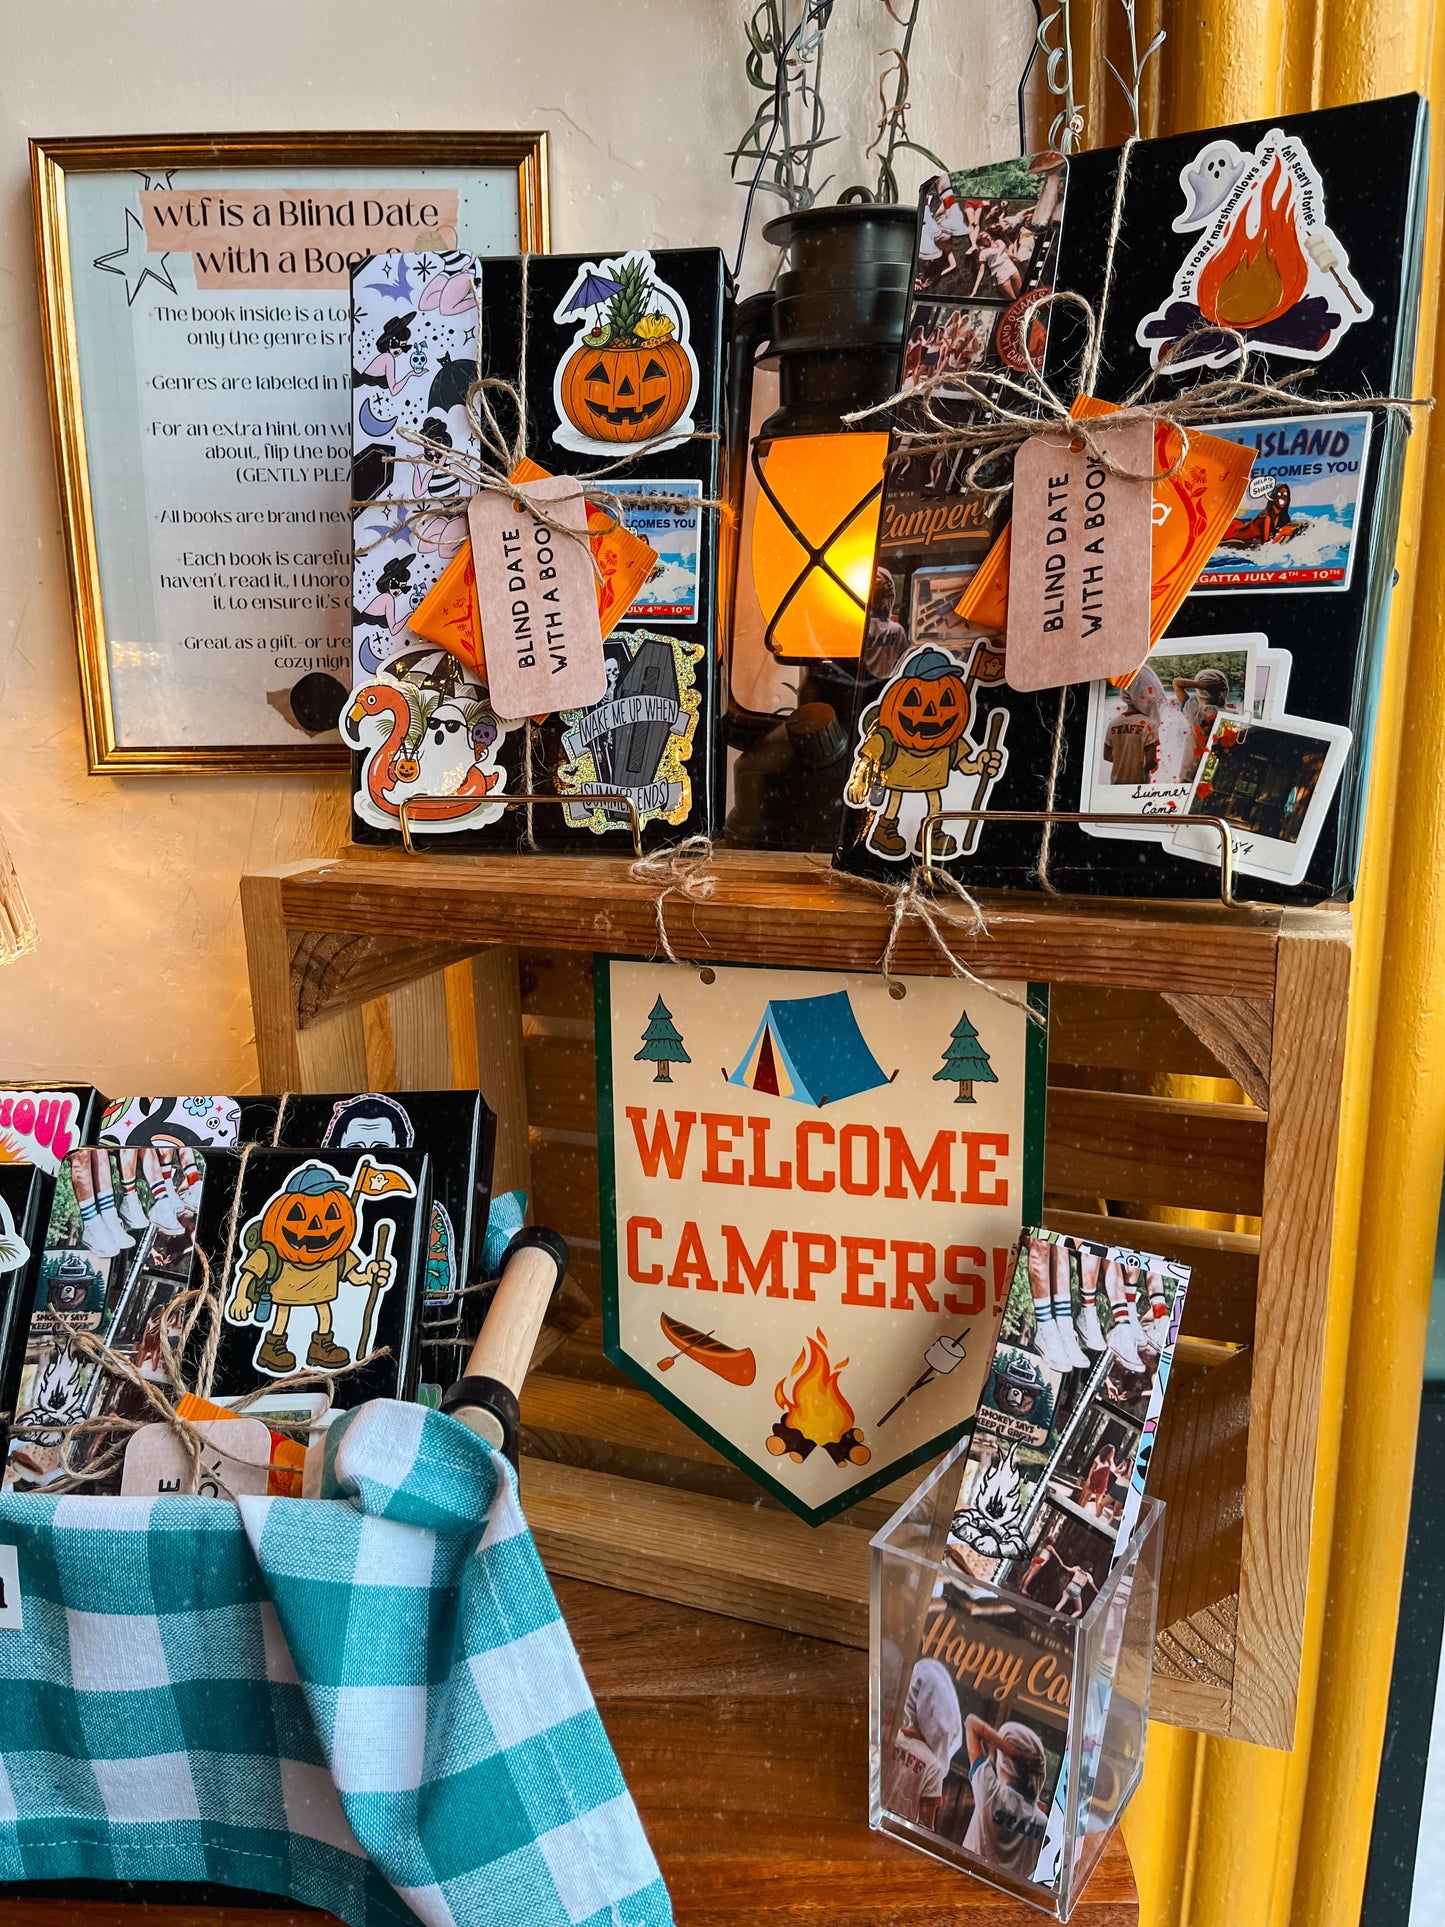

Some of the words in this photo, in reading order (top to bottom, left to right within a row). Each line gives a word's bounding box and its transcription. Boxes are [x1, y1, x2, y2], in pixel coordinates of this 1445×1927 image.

[1259, 147, 1275, 168] and
[1281, 144, 1297, 164] tell
[1292, 160, 1312, 190] scary
[153, 197, 212, 227] wtf
[219, 198, 244, 227] is
[252, 203, 271, 227] a
[279, 198, 354, 227] Blind
[363, 197, 439, 227] Date
[1211, 166, 1260, 240] marshmallows
[1300, 188, 1316, 226] stories
[196, 245, 269, 274] with
[278, 251, 296, 274] a
[1192, 240, 1215, 268] roast
[1179, 269, 1194, 298] Let's
[192, 306, 236, 321] book
[240, 305, 292, 321] inside
[295, 305, 310, 321] is
[313, 308, 324, 321] a
[187, 330, 225, 350] only
[229, 330, 260, 345] the
[263, 332, 317, 350] genre
[321, 329, 335, 345] is
[221, 377, 252, 390] are
[256, 375, 319, 390] labeled
[322, 374, 338, 390] in
[187, 423, 208, 436] an
[212, 420, 262, 436] extra
[266, 420, 301, 436] hint
[304, 423, 327, 436] on
[205, 443, 260, 461] about,
[264, 442, 290, 462] flip
[293, 443, 323, 459] the
[1255, 428, 1350, 459] ISLAND
[236, 467, 310, 484] (GENTLY
[1251, 462, 1323, 477] ELCOMES
[1326, 460, 1359, 473] YOU
[183, 510, 232, 523] books
[236, 510, 264, 523] are
[267, 509, 316, 523] brand
[1046, 473, 1069, 545] DATE
[673, 518, 696, 529] YOU
[1084, 537, 1104, 554] A
[229, 551, 272, 566] book
[276, 550, 290, 566] is
[502, 528, 527, 592] DATE
[160, 572, 227, 588] haven't
[229, 573, 270, 588] read
[274, 572, 290, 589] it,
[293, 573, 297, 588] I
[1244, 572, 1275, 582] JULY
[1278, 571, 1299, 580] 4TH
[1312, 569, 1341, 579] 10TH
[213, 594, 226, 610] it
[229, 595, 248, 610] to
[251, 596, 313, 610] ensure
[315, 594, 341, 610] it's
[542, 587, 560, 602] A
[1043, 554, 1066, 632] BLIND
[1081, 565, 1104, 638] WITH
[647, 605, 662, 614] 4TH
[671, 605, 691, 614] 10TH
[235, 637, 254, 650] as
[257, 637, 267, 650] a
[511, 600, 536, 668] BLIND
[544, 611, 567, 674] WITH
[274, 656, 313, 672] cozy
[581, 705, 611, 741] WAKE
[611, 700, 627, 726] ME
[628, 698, 642, 722] UP
[645, 697, 676, 723] WHEN
[1110, 724, 1145, 735] STAFF
[637, 781, 665, 811] ENDS
[1131, 784, 1189, 799] Summer
[1141, 801, 1178, 815] Camp
[625, 1106, 1010, 1207] WELCOME
[625, 1216, 1009, 1318] CAMPERS!
[36, 1313, 70, 1322] SMOEY
[70, 1313, 89, 1321] SAYS
[981, 1408, 1015, 1426] SMOKEY
[1015, 1420, 1035, 1433] SAYS
[921, 1612, 1024, 1701] Happy
